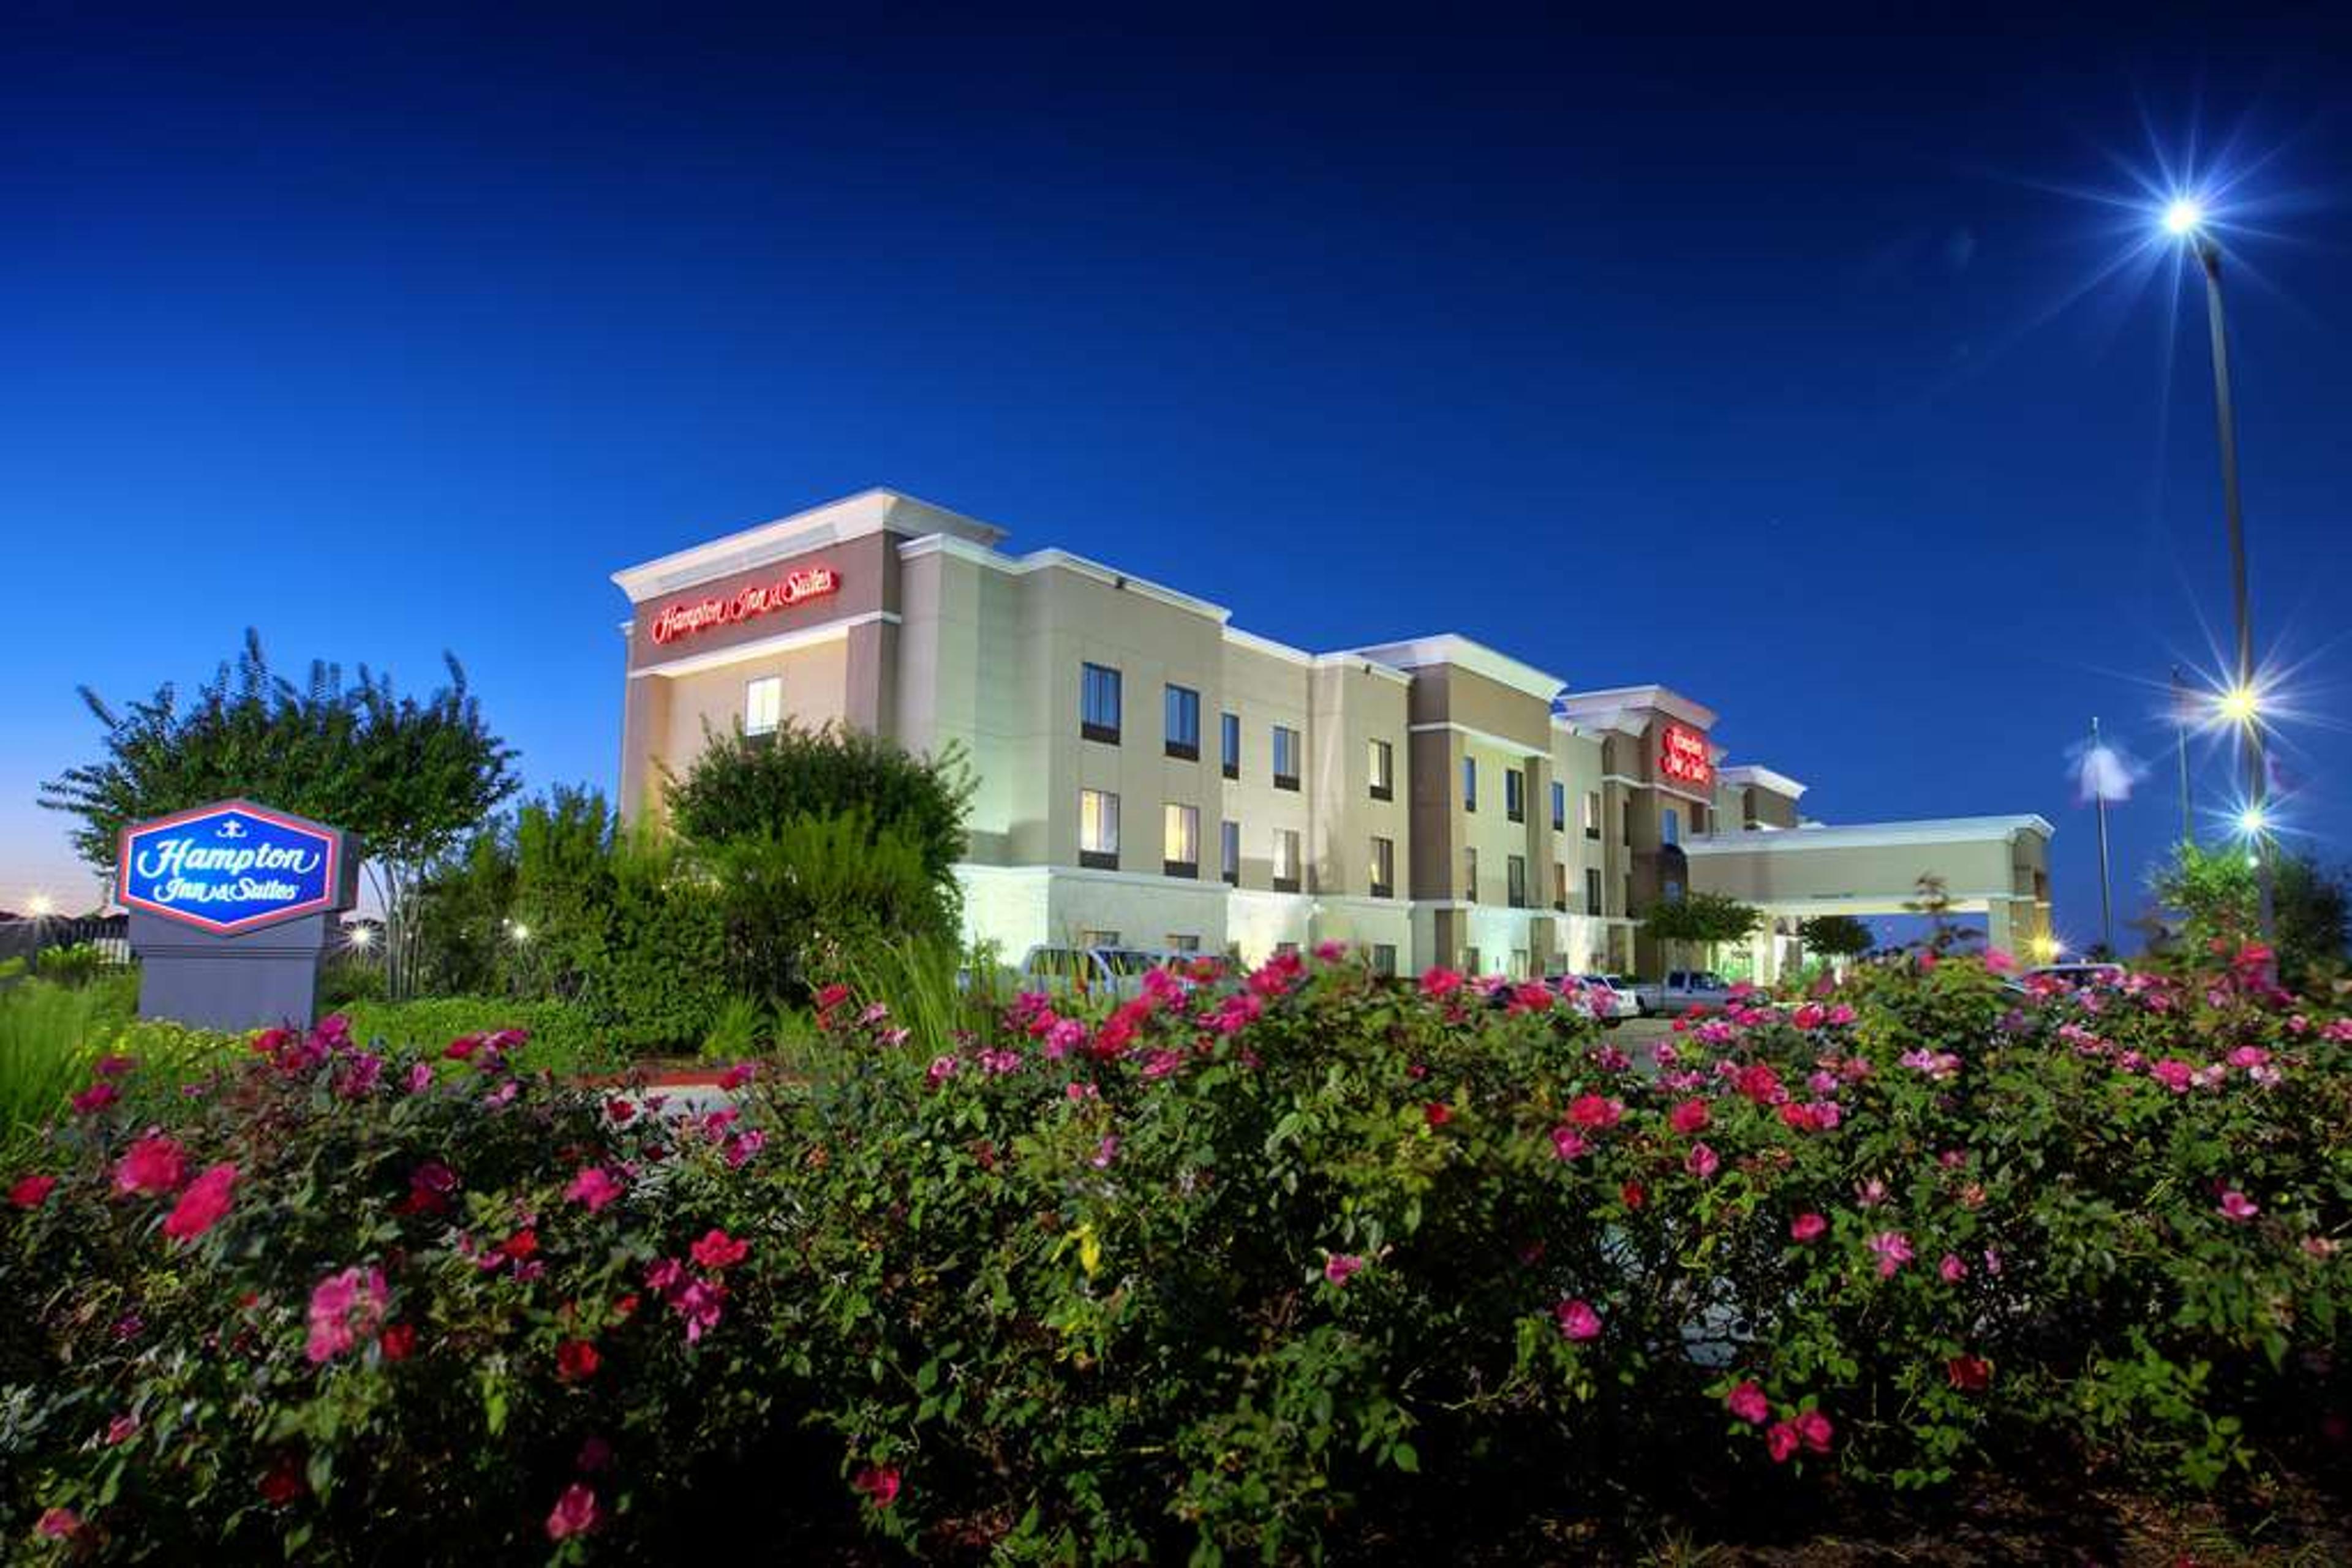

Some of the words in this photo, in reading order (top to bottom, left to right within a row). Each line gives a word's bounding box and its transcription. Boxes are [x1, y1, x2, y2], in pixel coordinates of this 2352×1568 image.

[652, 599, 732, 644] Hampton
[731, 587, 771, 619] Inn
[781, 569, 831, 601] Suites
[138, 838, 320, 878] Hampton
[154, 878, 216, 902] Inn
[216, 884, 231, 901] &
[229, 877, 296, 900] Suites
